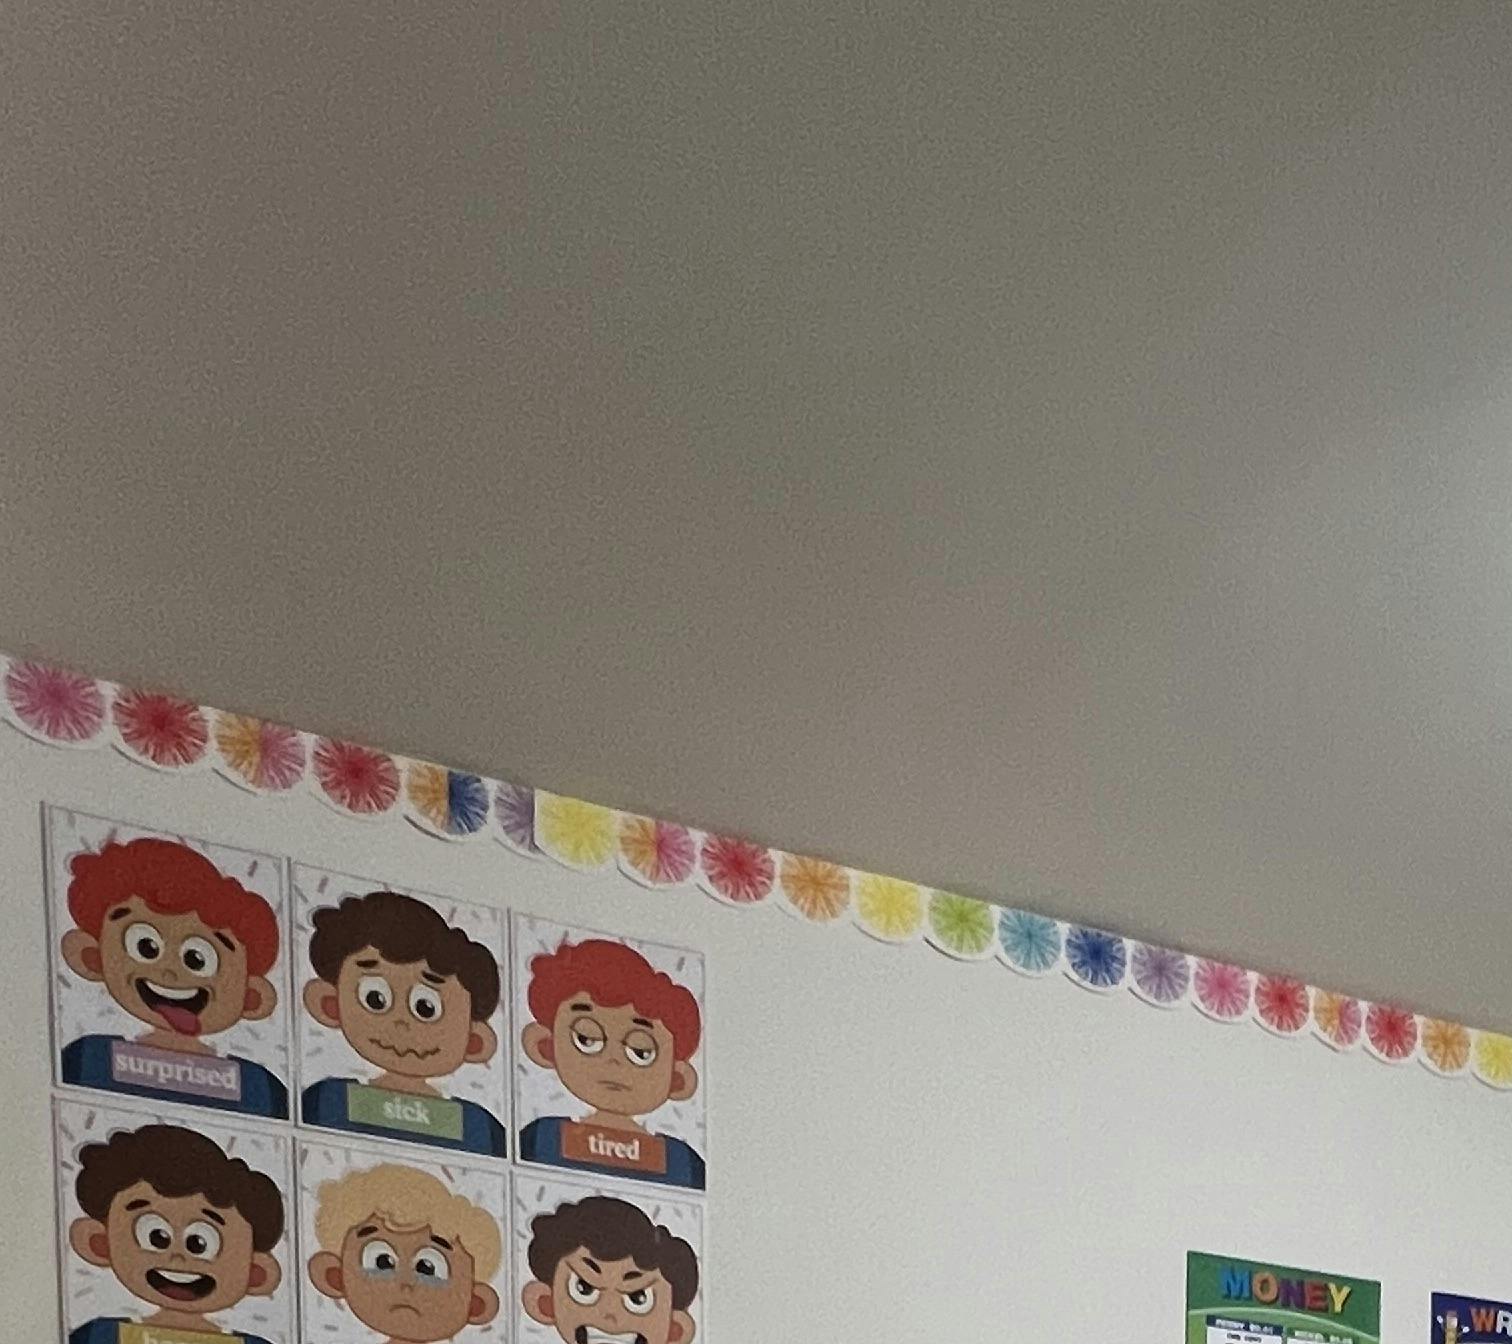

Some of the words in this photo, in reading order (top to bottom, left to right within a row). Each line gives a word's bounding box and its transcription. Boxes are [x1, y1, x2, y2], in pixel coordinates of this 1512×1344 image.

[116, 1051, 237, 1091] surprised
[383, 1096, 431, 1125] sick
[588, 1134, 640, 1161] tired
[1219, 1264, 1352, 1314] MONEY
